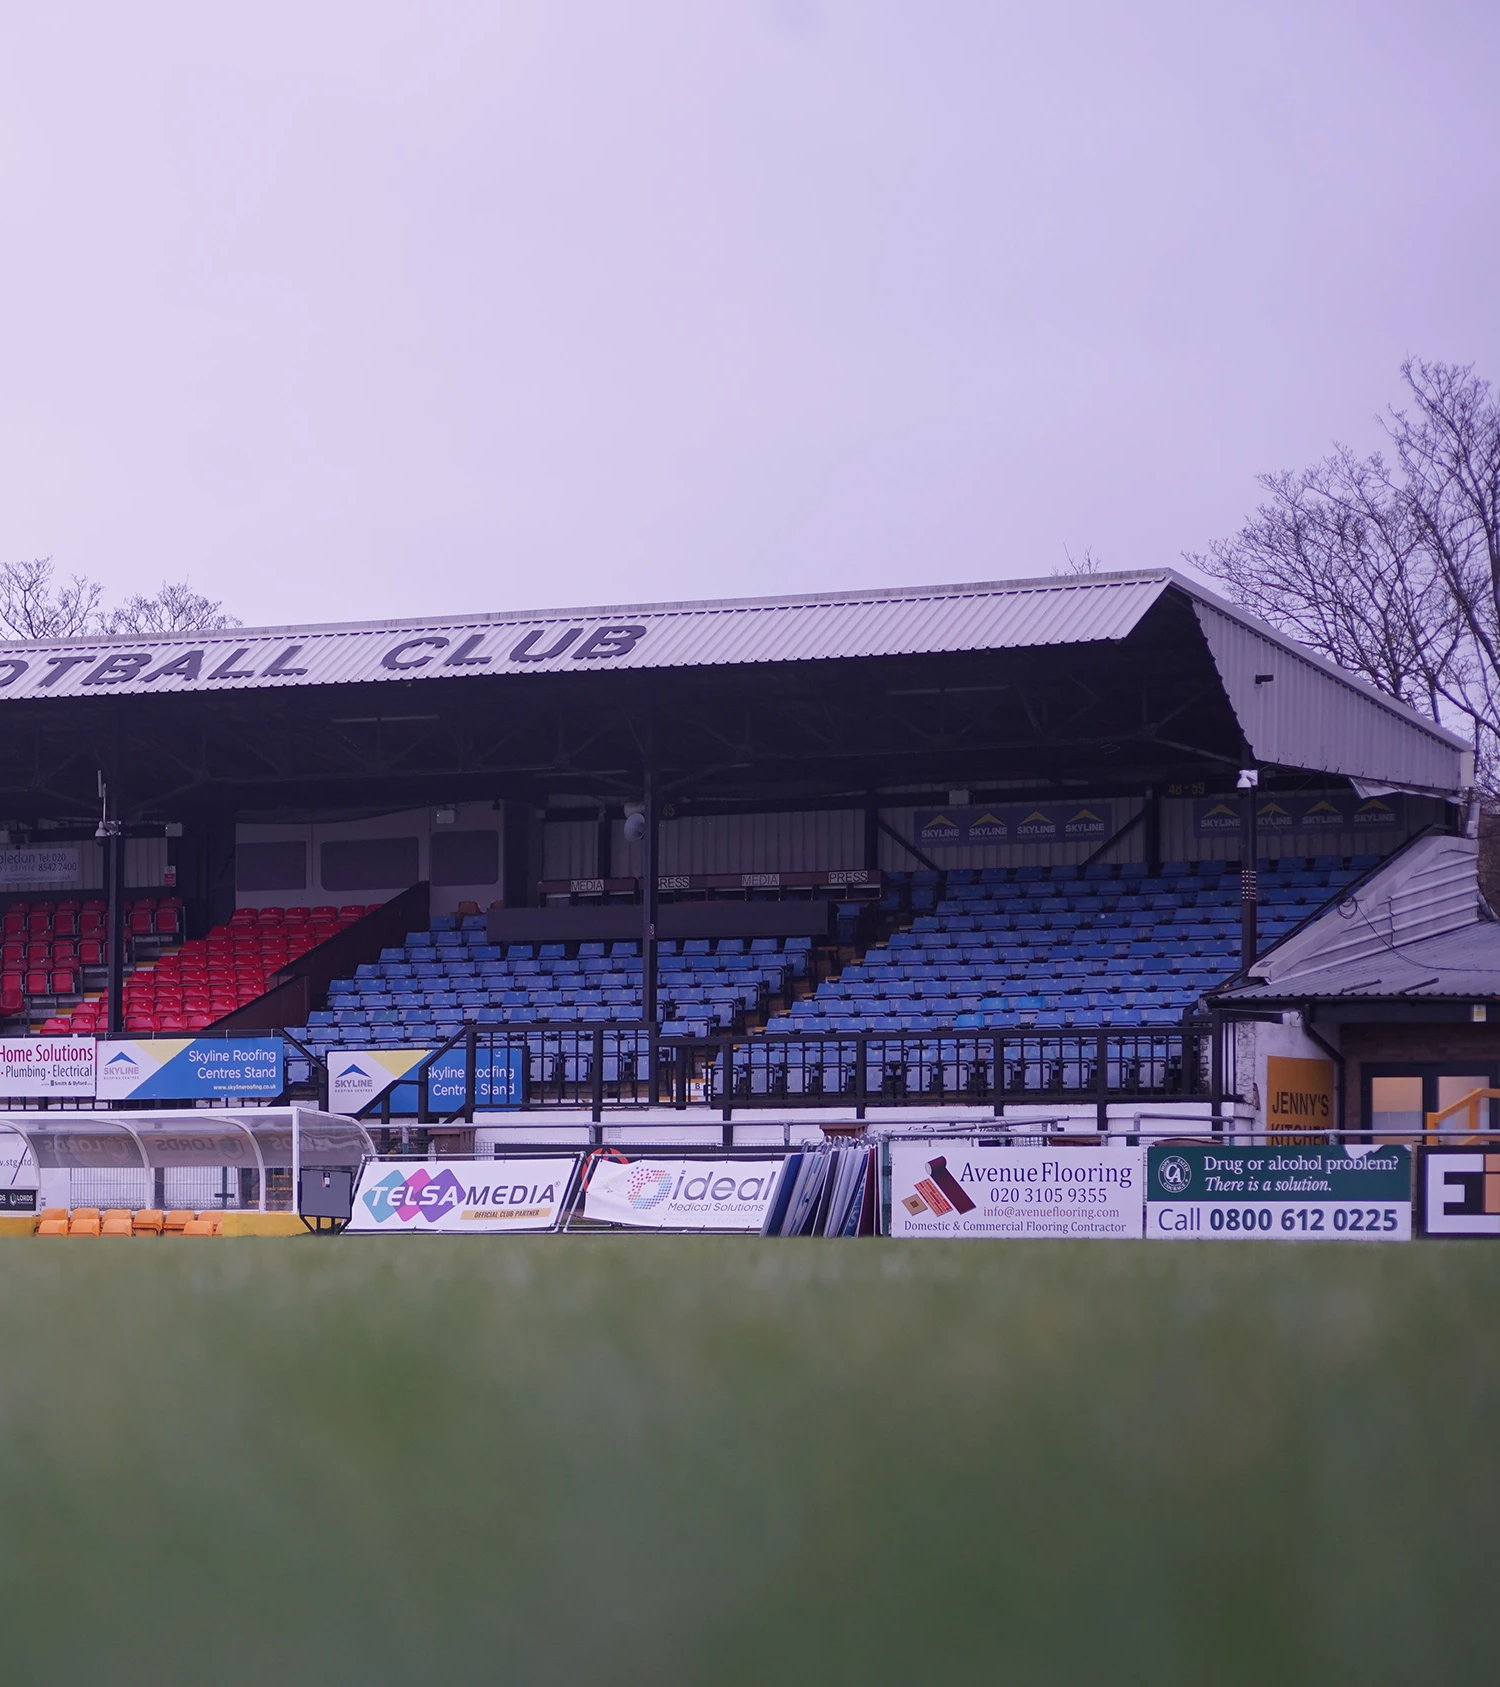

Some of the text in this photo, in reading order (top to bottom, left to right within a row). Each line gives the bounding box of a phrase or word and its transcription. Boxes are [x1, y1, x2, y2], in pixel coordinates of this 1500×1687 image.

[381, 625, 647, 669] CLUB
[1017, 825, 1056, 834] SKYLINE
[1065, 823, 1105, 832] SKYLINE
[1201, 818, 1241, 828] SKYLINE
[921, 829, 960, 838] SKYLINE
[968, 827, 1008, 836] SKYLINE
[52, 853, 66, 861] 020
[38, 863, 56, 872] 8542
[59, 862, 77, 871] 2400
[659, 877, 690, 889] RESS
[742, 875, 779, 886] MEDIA
[829, 871, 868, 883] PRESS
[571, 880, 604, 892] MEDIA
[36, 1044, 93, 1062] Solutions
[188, 1049, 276, 1065] Skyline Roofing
[5, 1064, 46, 1080] Plumbing
[52, 1064, 92, 1077] Electrical
[104, 1067, 139, 1075] SKYLINE
[197, 1066, 276, 1079] Centres Stand
[474, 1065, 515, 1080] oofing
[334, 1079, 373, 1088] SKYLINE
[433, 1082, 515, 1096] Centrs Stand
[1272, 1091, 1329, 1117] JENNY'S
[1204, 1155, 1399, 1174] Drug or alcohol problem?
[960, 1162, 1132, 1188] Avenue Flooring
[673, 1170, 776, 1201] ideal
[1204, 1177, 1332, 1192] There is a solution.
[990, 1188, 1107, 1203] 020 3105 9355
[667, 1201, 765, 1212] Medical Solutions
[983, 1206, 1120, 1220] info@avenueflooring.com
[474, 1211, 498, 1219] OFFICIAL
[500, 1210, 513, 1218] CLUB
[1158, 1207, 1399, 1232] Call 0800 612 0225
[904, 1221, 1126, 1234] Domestic & Commercial Flooring Contractor
